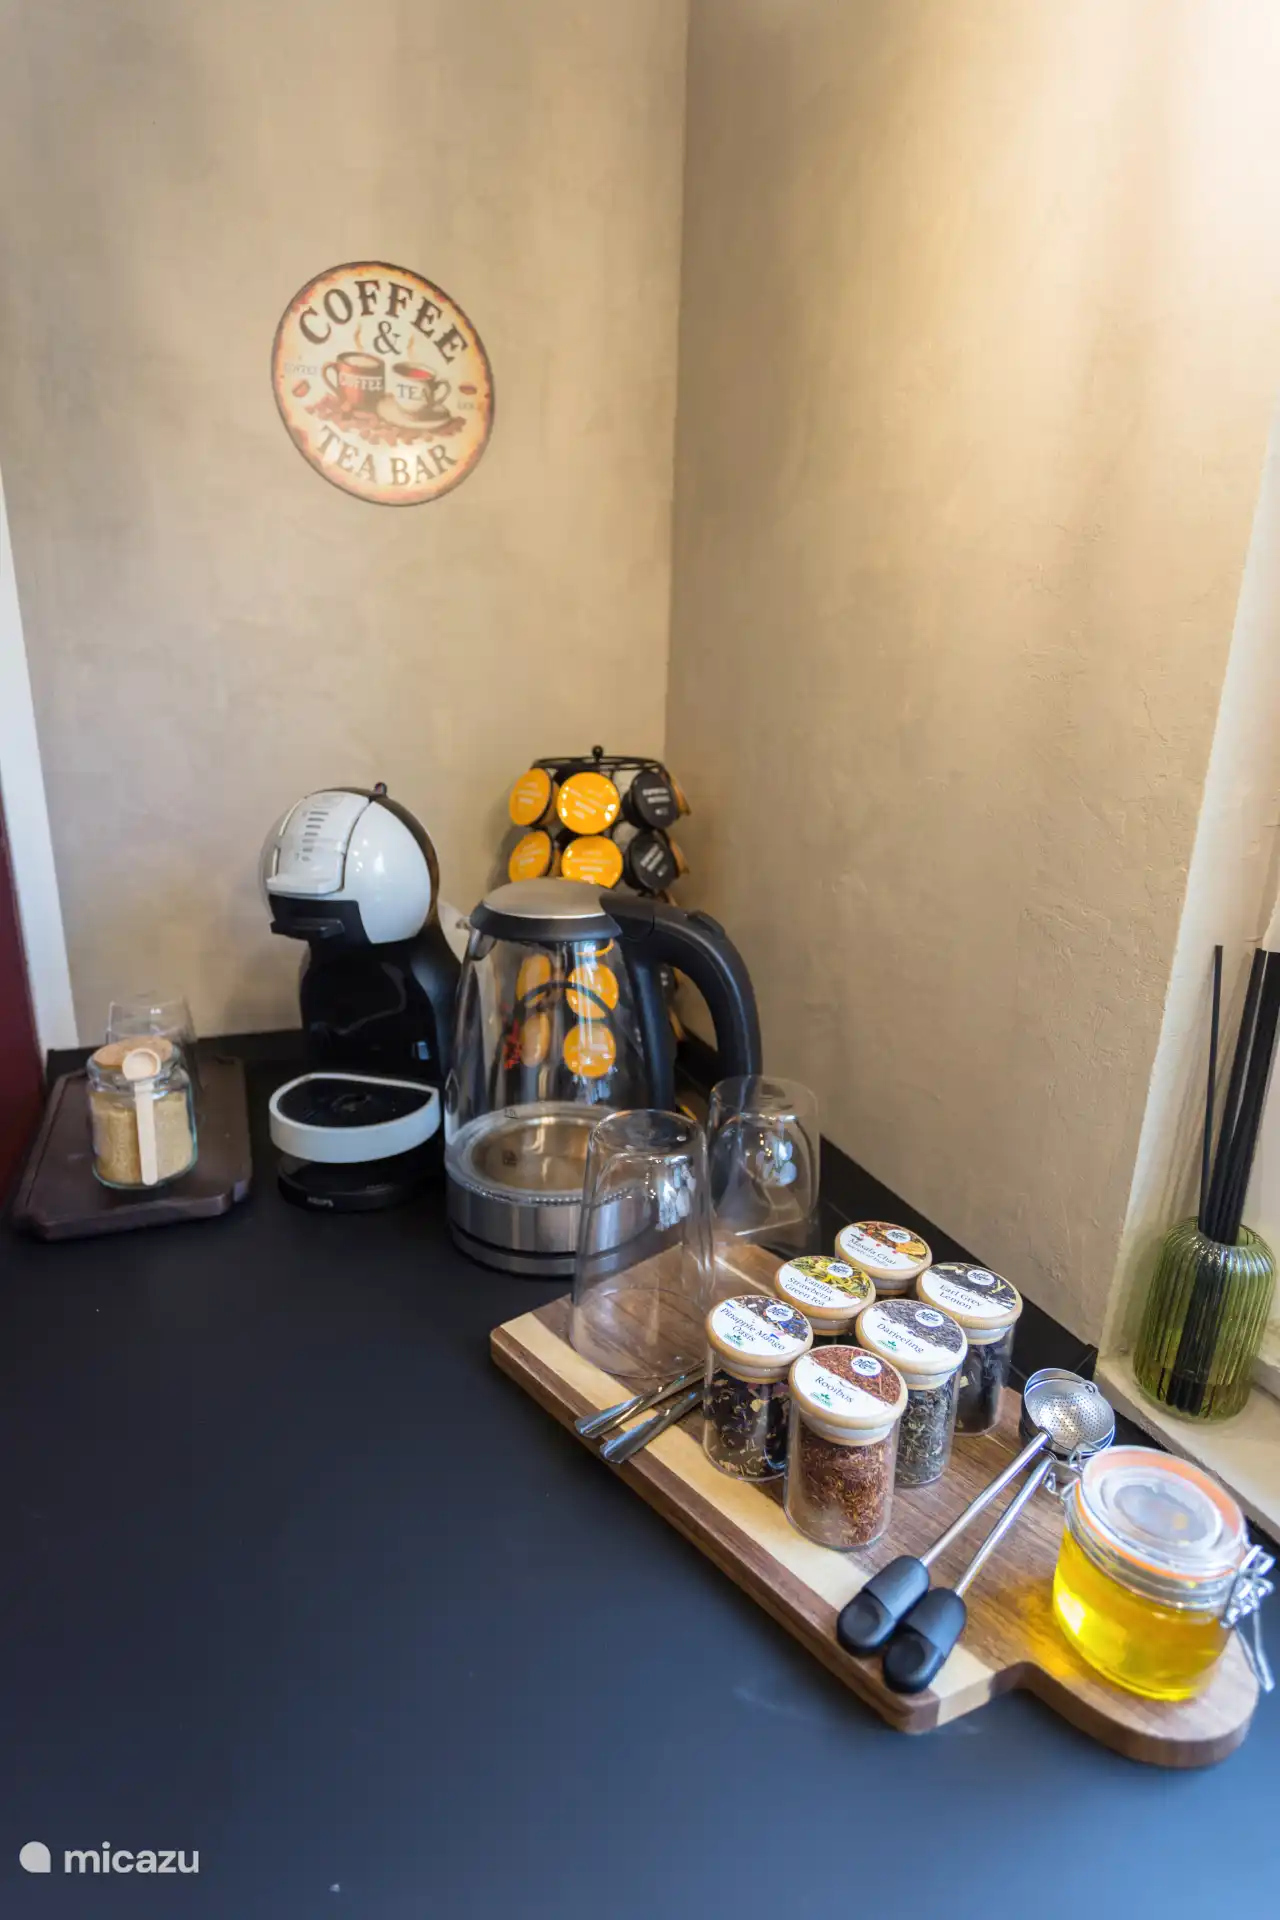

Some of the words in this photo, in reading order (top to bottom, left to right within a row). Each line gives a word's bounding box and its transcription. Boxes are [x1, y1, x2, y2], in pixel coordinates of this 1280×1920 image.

[299, 279, 469, 365] COFFEE
[373, 321, 401, 356] &
[317, 425, 377, 483] TEA
[390, 444, 458, 486] BAR
[784, 1284, 810, 1299] Green
[787, 1277, 833, 1301] Strawberry
[804, 1276, 833, 1295] Vanilla
[940, 1284, 960, 1296] Earl
[960, 1294, 982, 1307] Grey
[939, 1291, 972, 1310] Lemon
[733, 1325, 756, 1342] Oasis
[755, 1329, 786, 1351] Mango
[876, 1323, 924, 1353] Darjeeling
[815, 1376, 854, 1403] Rooibos
